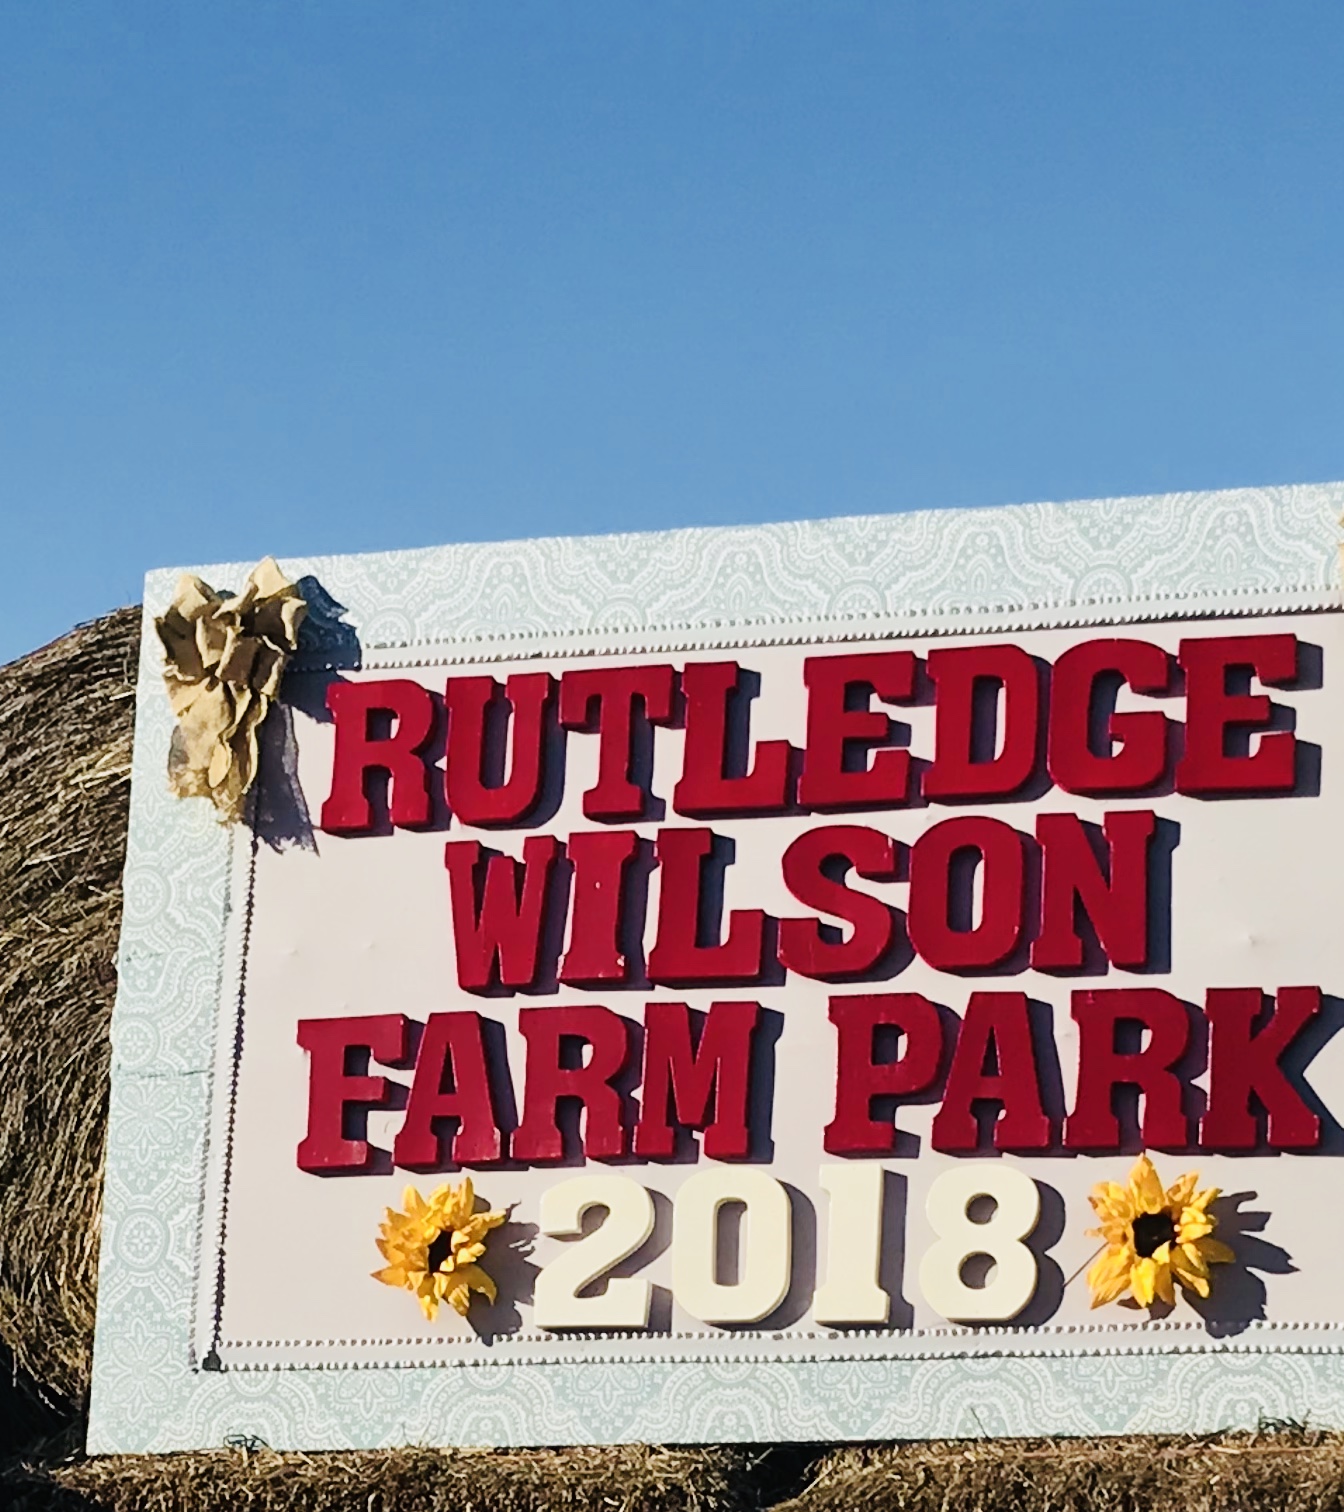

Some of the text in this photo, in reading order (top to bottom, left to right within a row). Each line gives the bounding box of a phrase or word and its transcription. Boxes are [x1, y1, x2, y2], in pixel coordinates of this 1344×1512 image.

[320, 632, 1297, 833] RUTLEDGE
[444, 809, 1155, 992] WILSON
[296, 986, 1321, 1172] FARM PARK
[534, 1164, 1041, 1328] 2018
